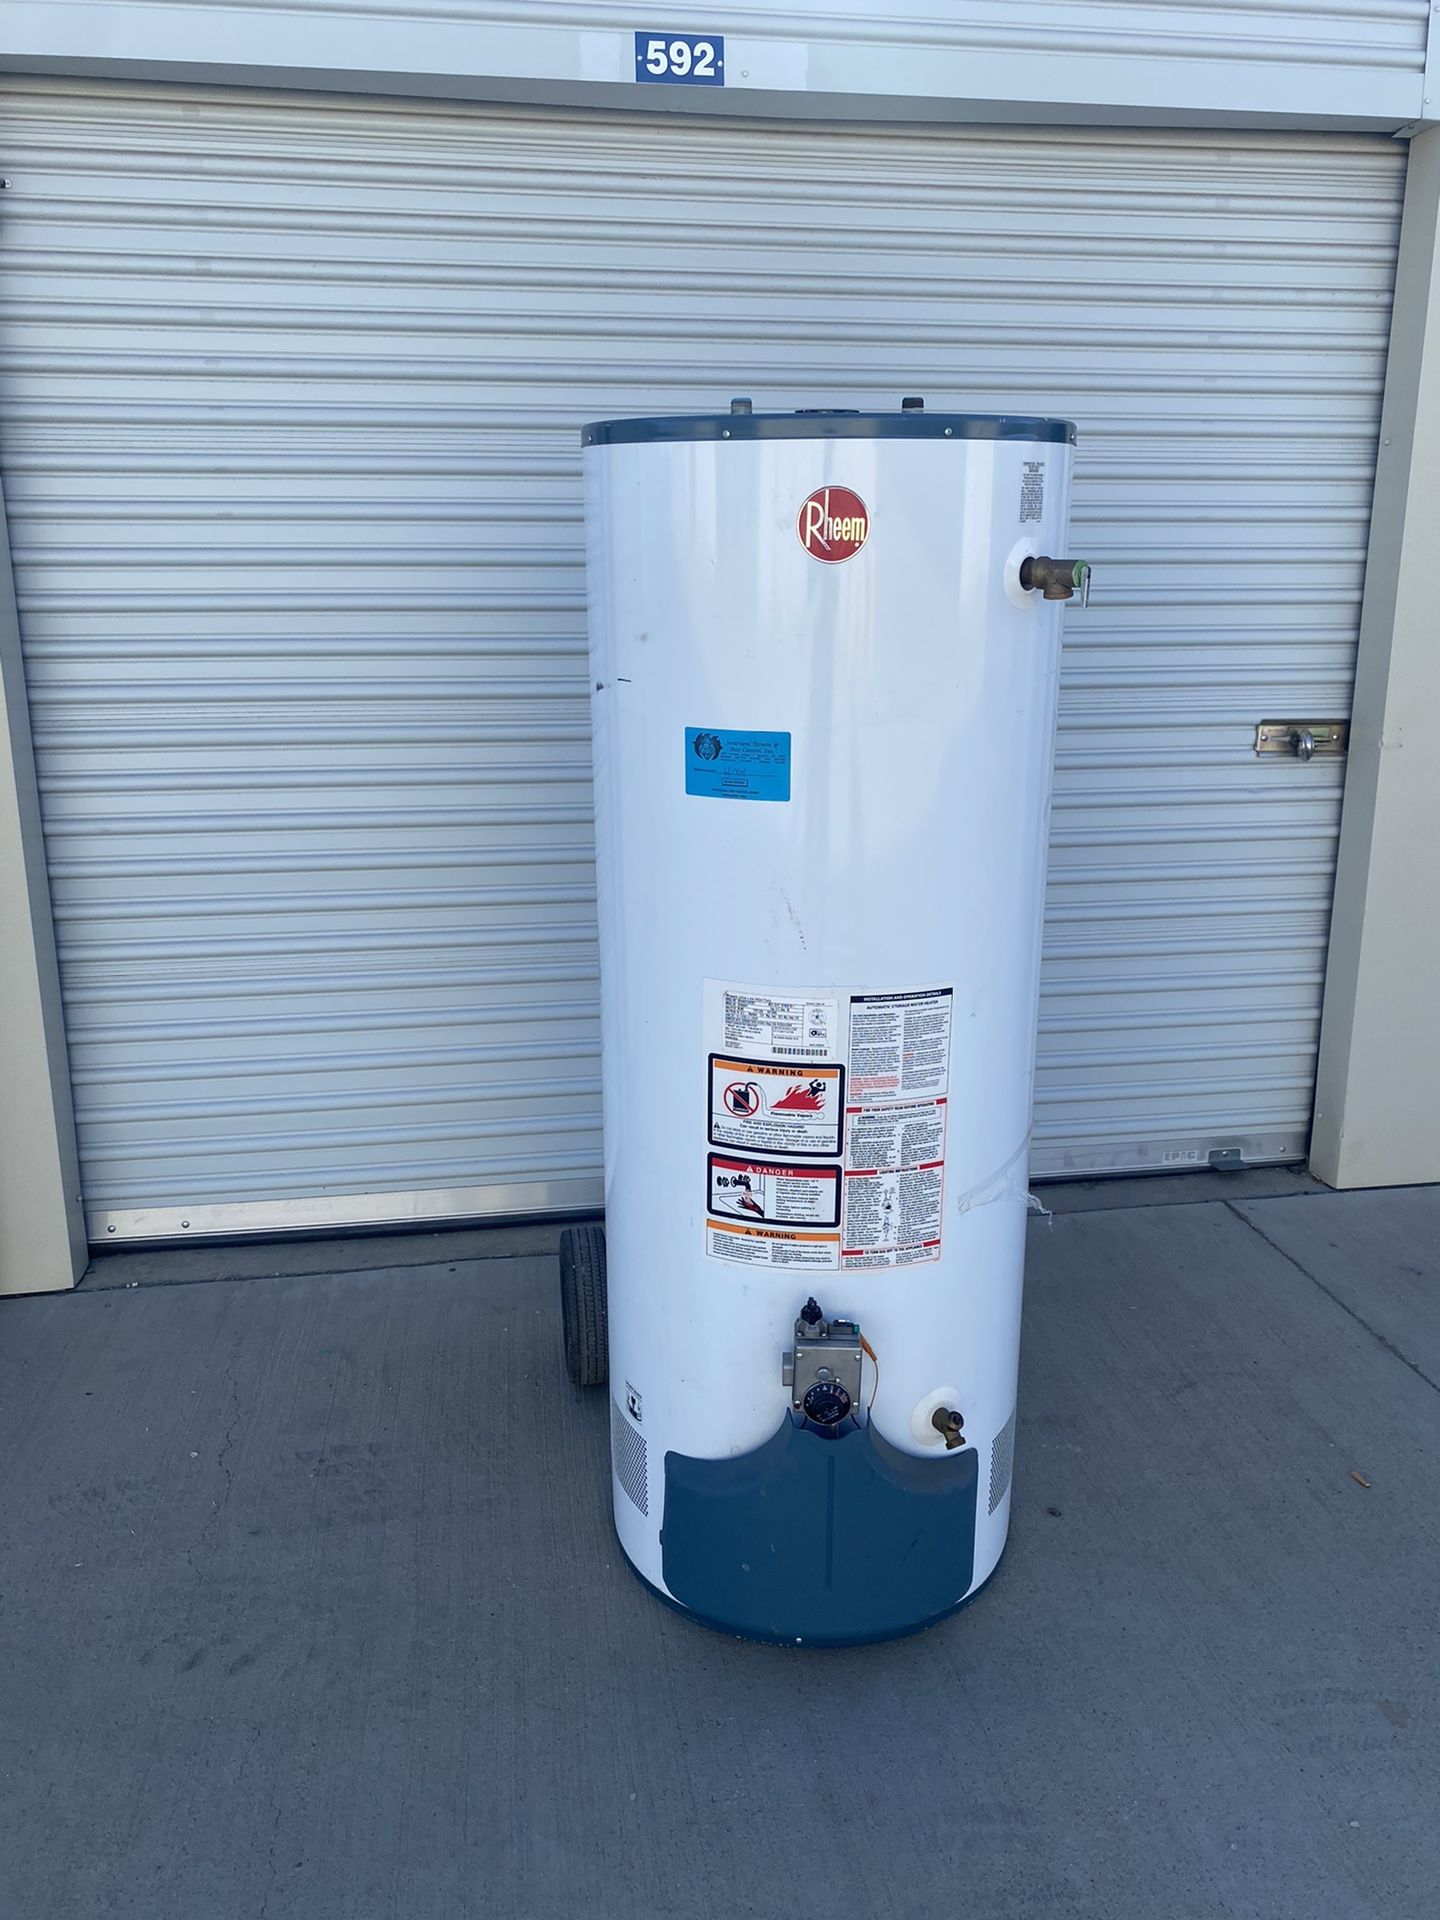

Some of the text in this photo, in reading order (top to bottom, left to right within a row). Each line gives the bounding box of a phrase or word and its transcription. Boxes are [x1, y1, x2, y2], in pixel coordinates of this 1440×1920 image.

[646, 40, 715, 76] 592
[806, 489, 866, 551] Rheem
[757, 1067, 803, 1076] WARNING
[756, 1167, 794, 1176] DANGER
[756, 1230, 797, 1240] WARNING
